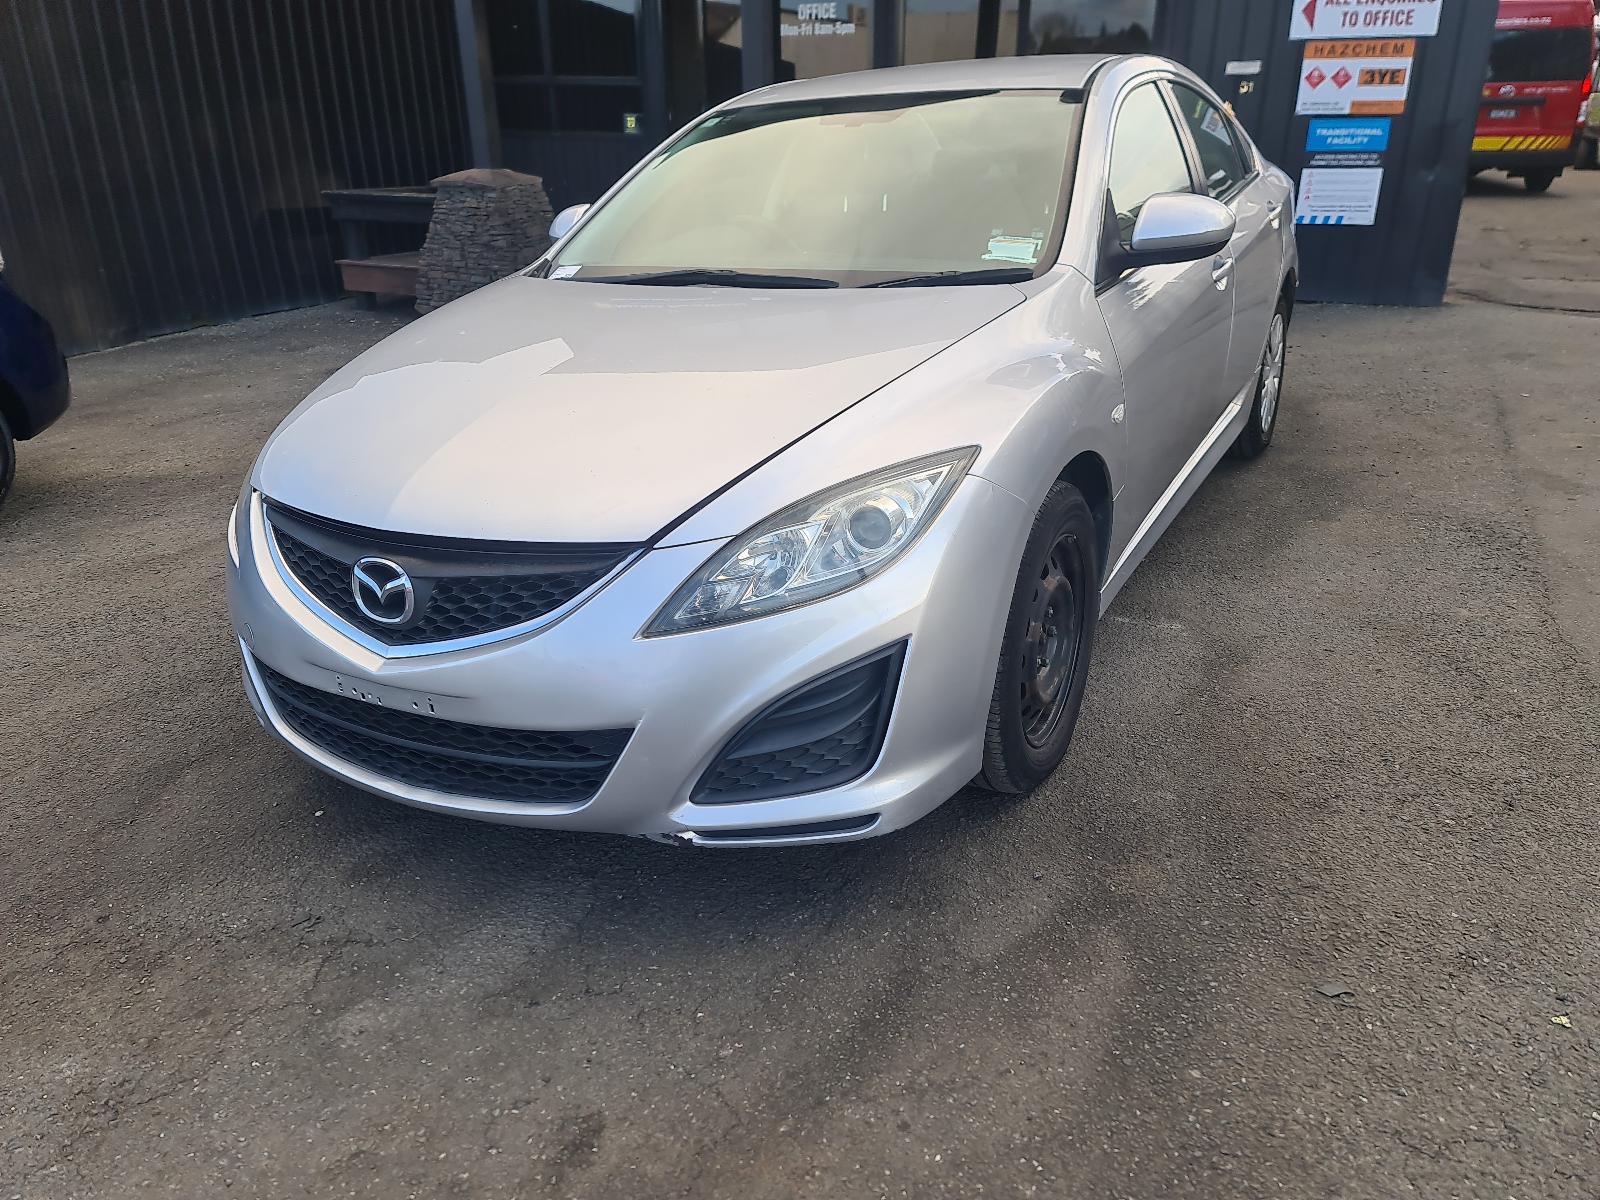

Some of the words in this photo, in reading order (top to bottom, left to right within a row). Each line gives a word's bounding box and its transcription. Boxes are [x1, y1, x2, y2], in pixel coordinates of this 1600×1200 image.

[798, 2, 837, 20] OFFICE
[1341, 9, 1360, 28] TO
[1363, 8, 1415, 27] OFFICE
[1313, 42, 1405, 57] HAZCHEM
[1364, 68, 1401, 84] 3YE
[1326, 136, 1369, 145] FACILITY
